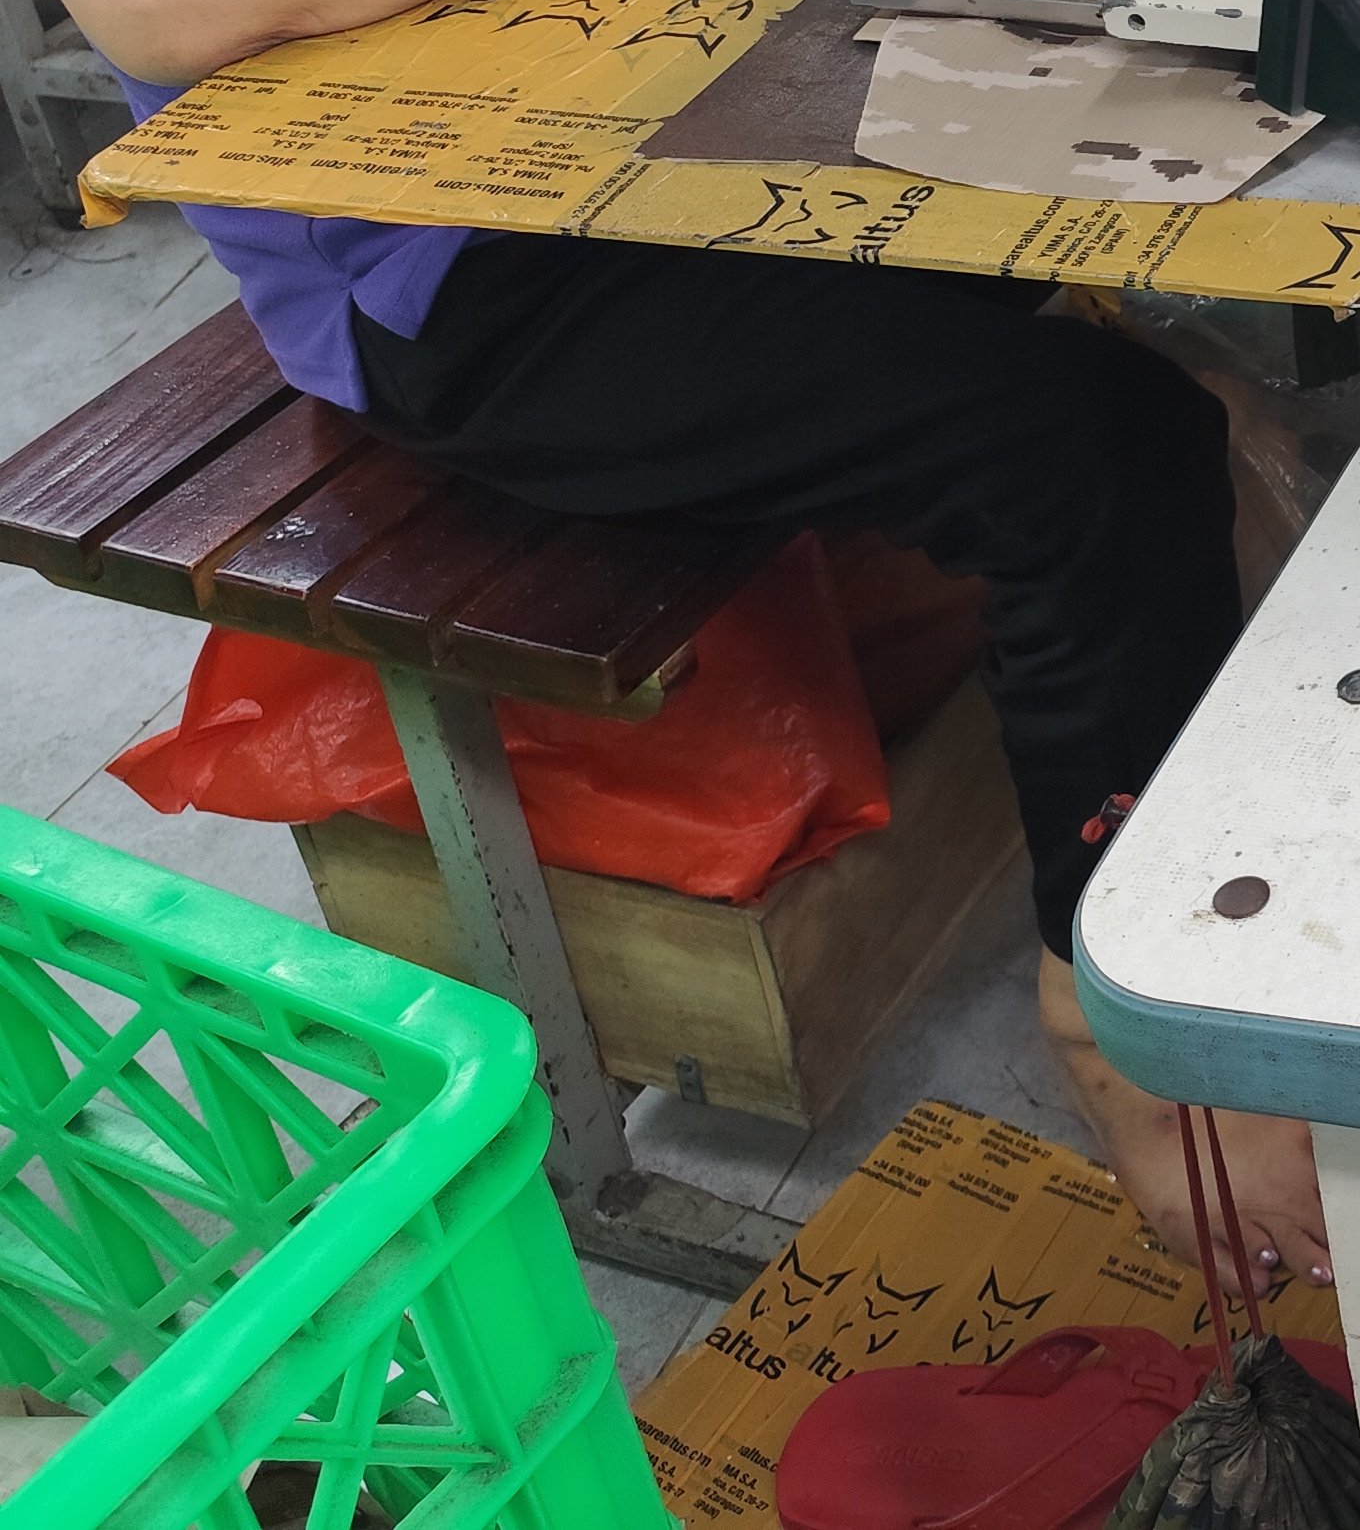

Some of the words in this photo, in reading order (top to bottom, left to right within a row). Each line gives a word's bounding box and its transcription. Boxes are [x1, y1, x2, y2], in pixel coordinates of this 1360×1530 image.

[512, 168, 553, 182] YUMA
[433, 179, 566, 200] wearealtus.com
[848, 184, 936, 267] altus
[1037, 232, 1069, 260] YUMA
[1059, 214, 1085, 238] S.A.
[1146, 233, 1166, 250] 976
[1156, 218, 1177, 236] 330
[1169, 203, 1189, 220] 000
[1099, 227, 1132, 255] (SPAIN)
[705, 1325, 787, 1381] altus
[738, 1471, 759, 1492] S.A.
[742, 1492, 771, 1513] 26-27
